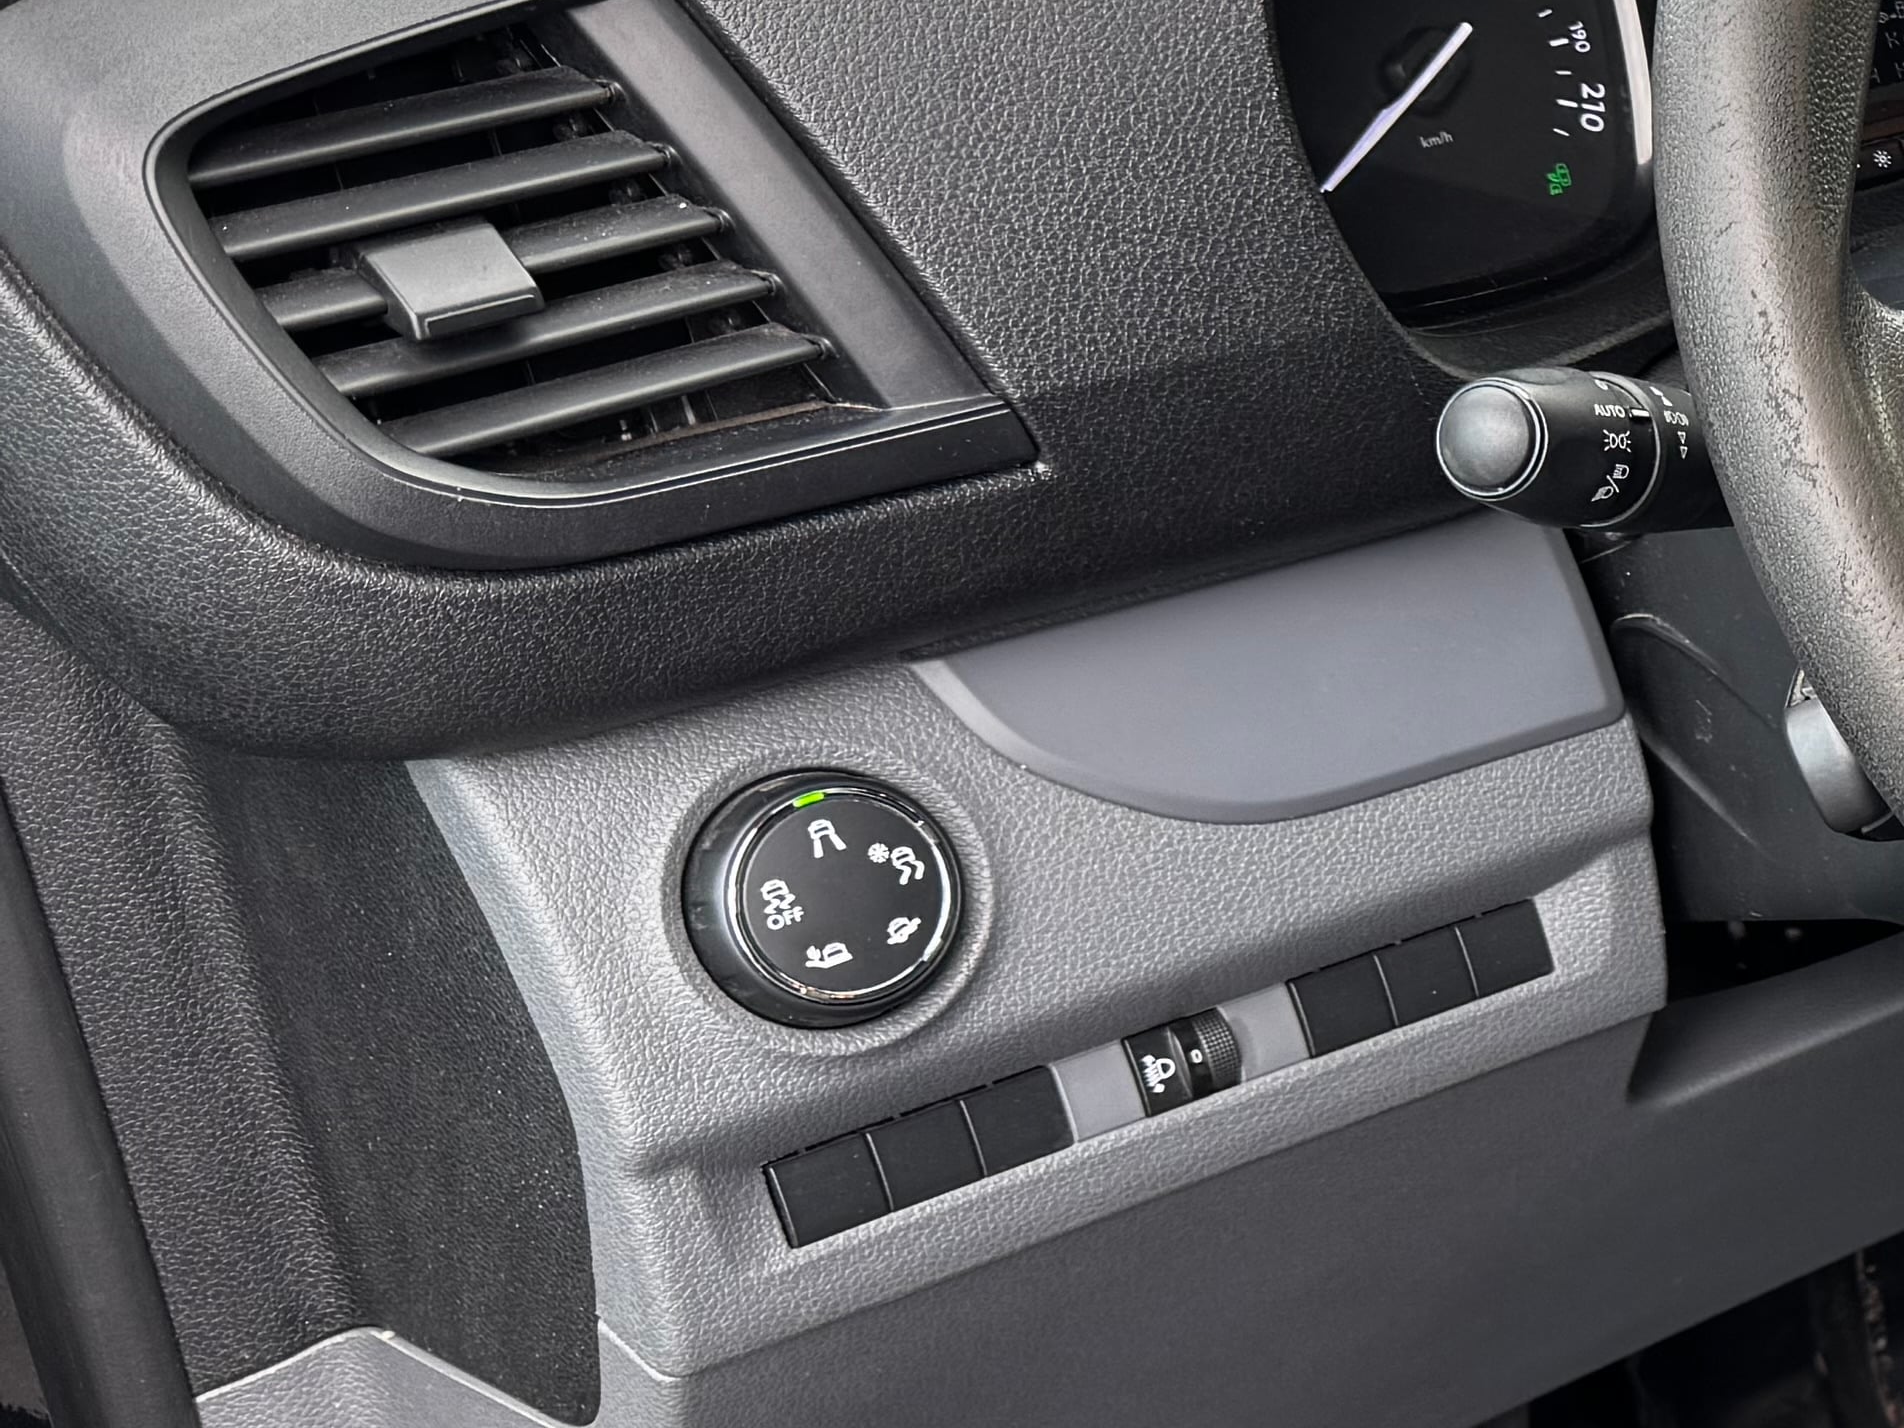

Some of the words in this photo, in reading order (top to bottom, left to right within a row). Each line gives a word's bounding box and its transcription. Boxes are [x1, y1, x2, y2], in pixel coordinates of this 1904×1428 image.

[1568, 20, 1591, 53] 190
[1580, 82, 1606, 133] 210
[1419, 130, 1454, 149] km/h
[1593, 403, 1626, 418] AUTO
[766, 905, 805, 931] OFF
